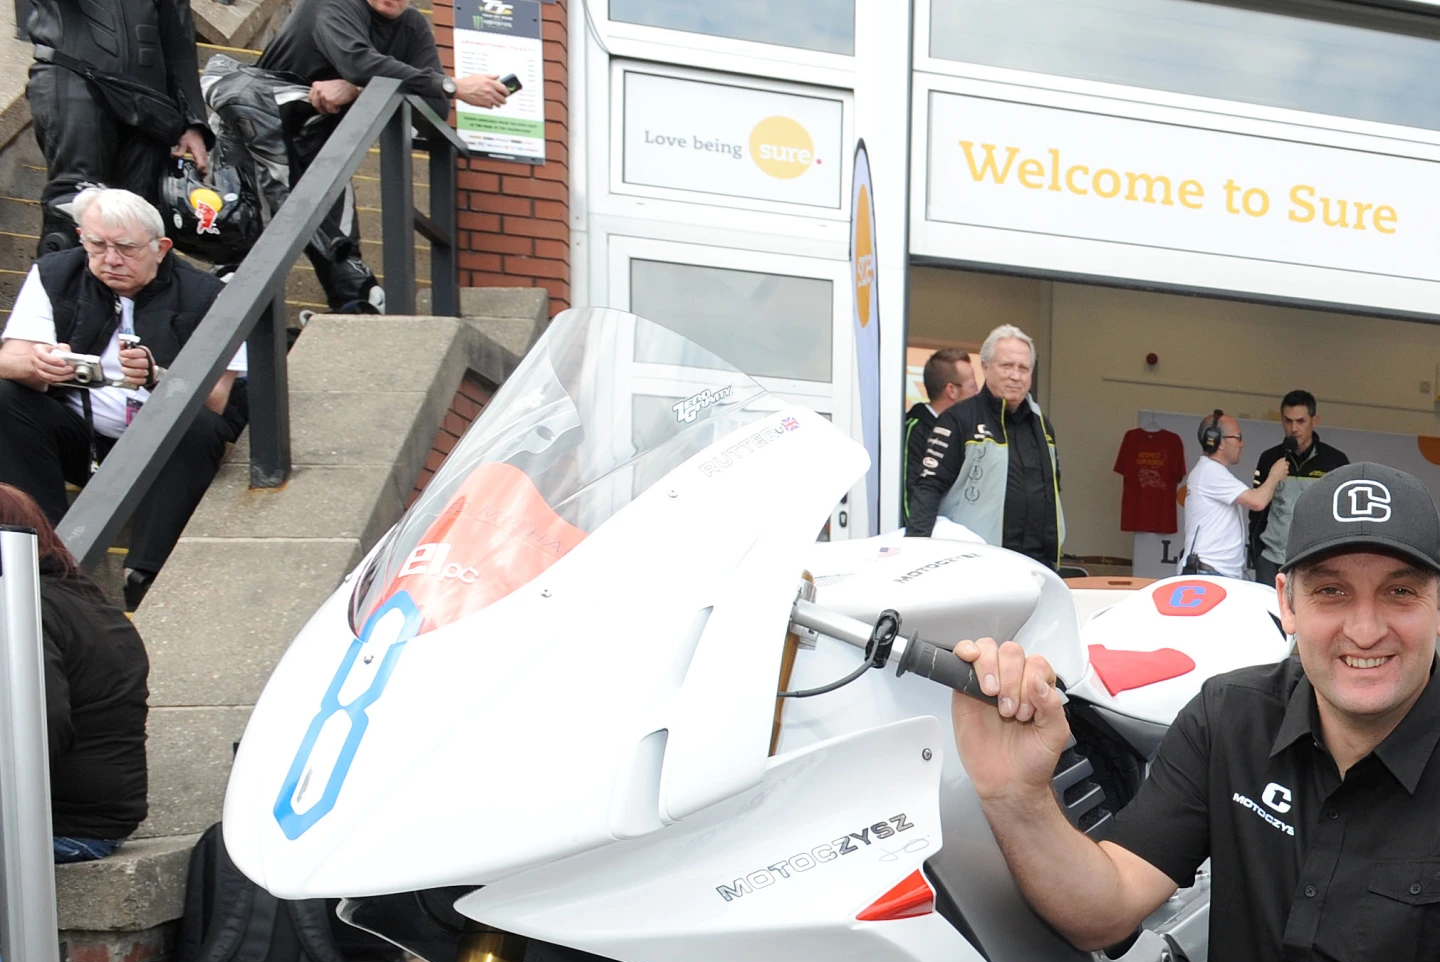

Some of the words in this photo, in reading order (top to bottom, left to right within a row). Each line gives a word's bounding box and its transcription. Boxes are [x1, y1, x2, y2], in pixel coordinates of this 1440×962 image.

[644, 129, 688, 149] Love
[693, 133, 743, 159] being
[958, 139, 1205, 210] Welcome
[1222, 177, 1271, 219] to
[1287, 184, 1399, 235] Sure
[699, 425, 783, 478] RUTTER
[715, 812, 915, 902] MOTOCZYSZ
